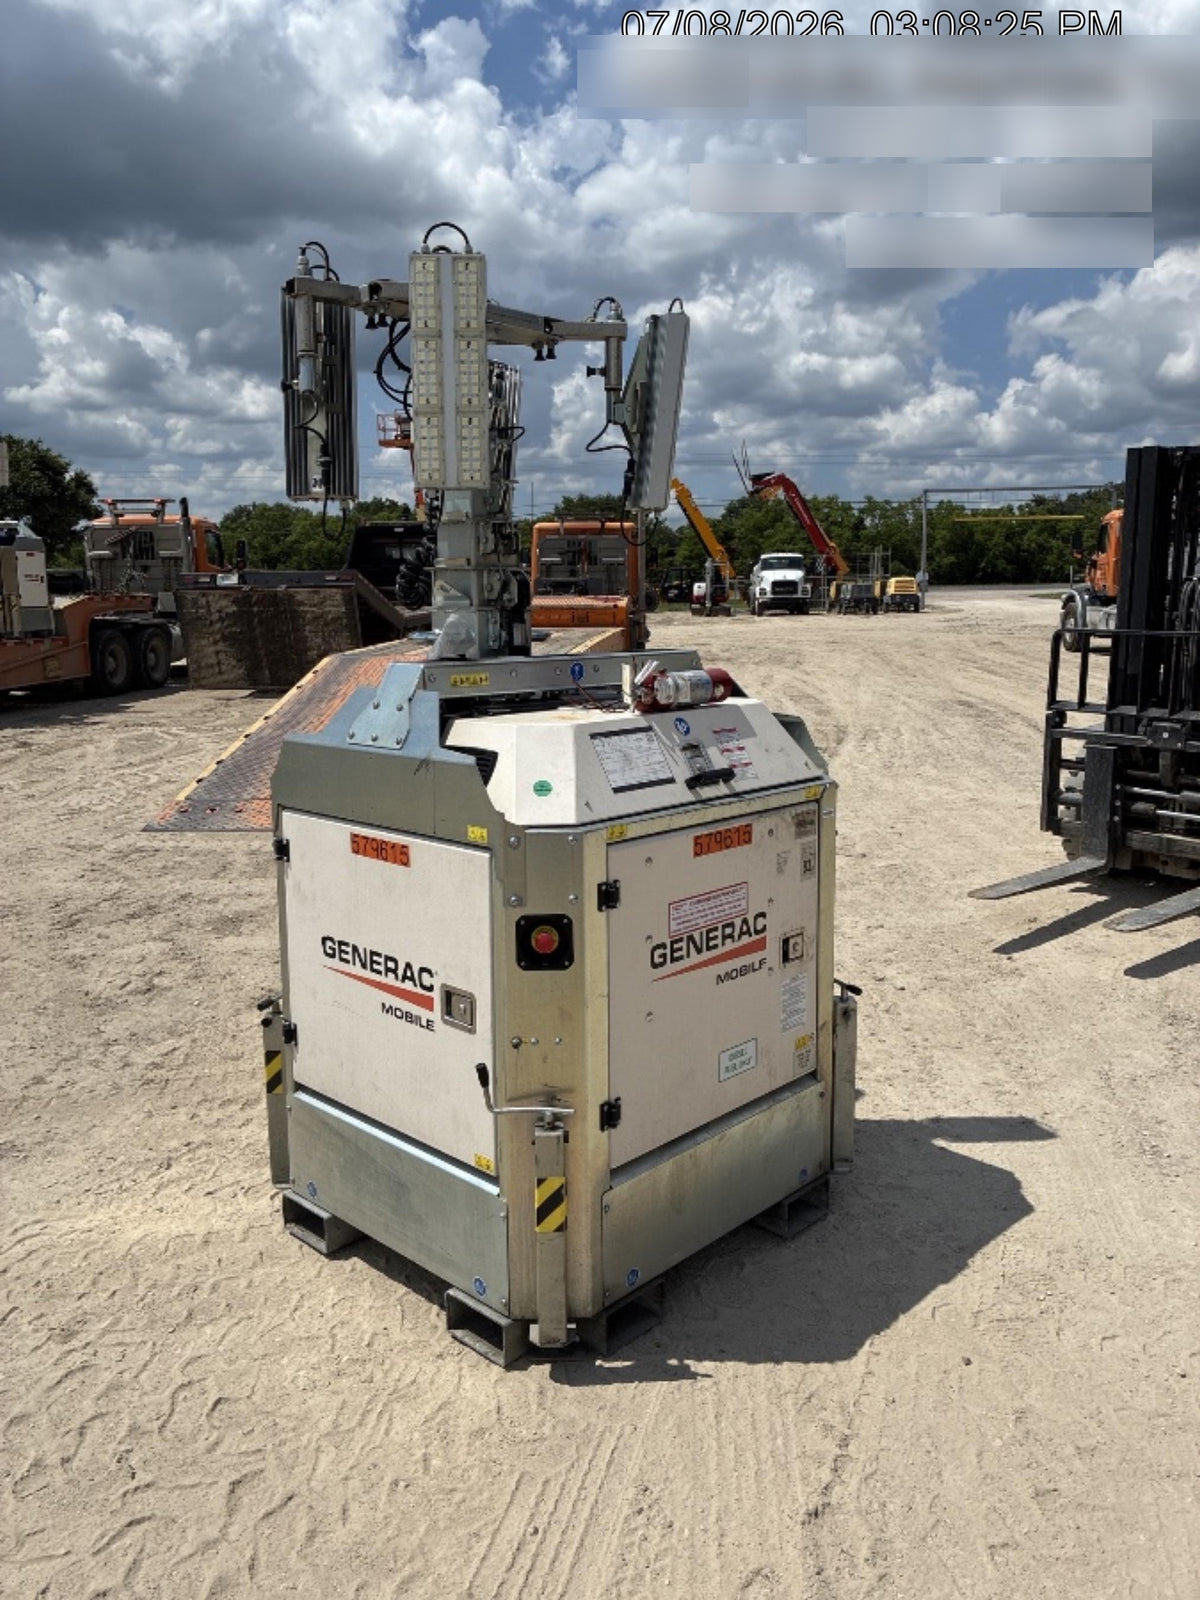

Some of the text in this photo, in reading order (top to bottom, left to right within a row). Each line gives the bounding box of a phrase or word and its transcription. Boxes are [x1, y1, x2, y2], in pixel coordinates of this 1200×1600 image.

[351, 833, 409, 867] 579615
[694, 824, 752, 857] 579615
[650, 911, 767, 970] GENERAC
[321, 935, 434, 992] GENERAC
[716, 958, 767, 985] MOBILE
[381, 1002, 436, 1032] MOBILE
